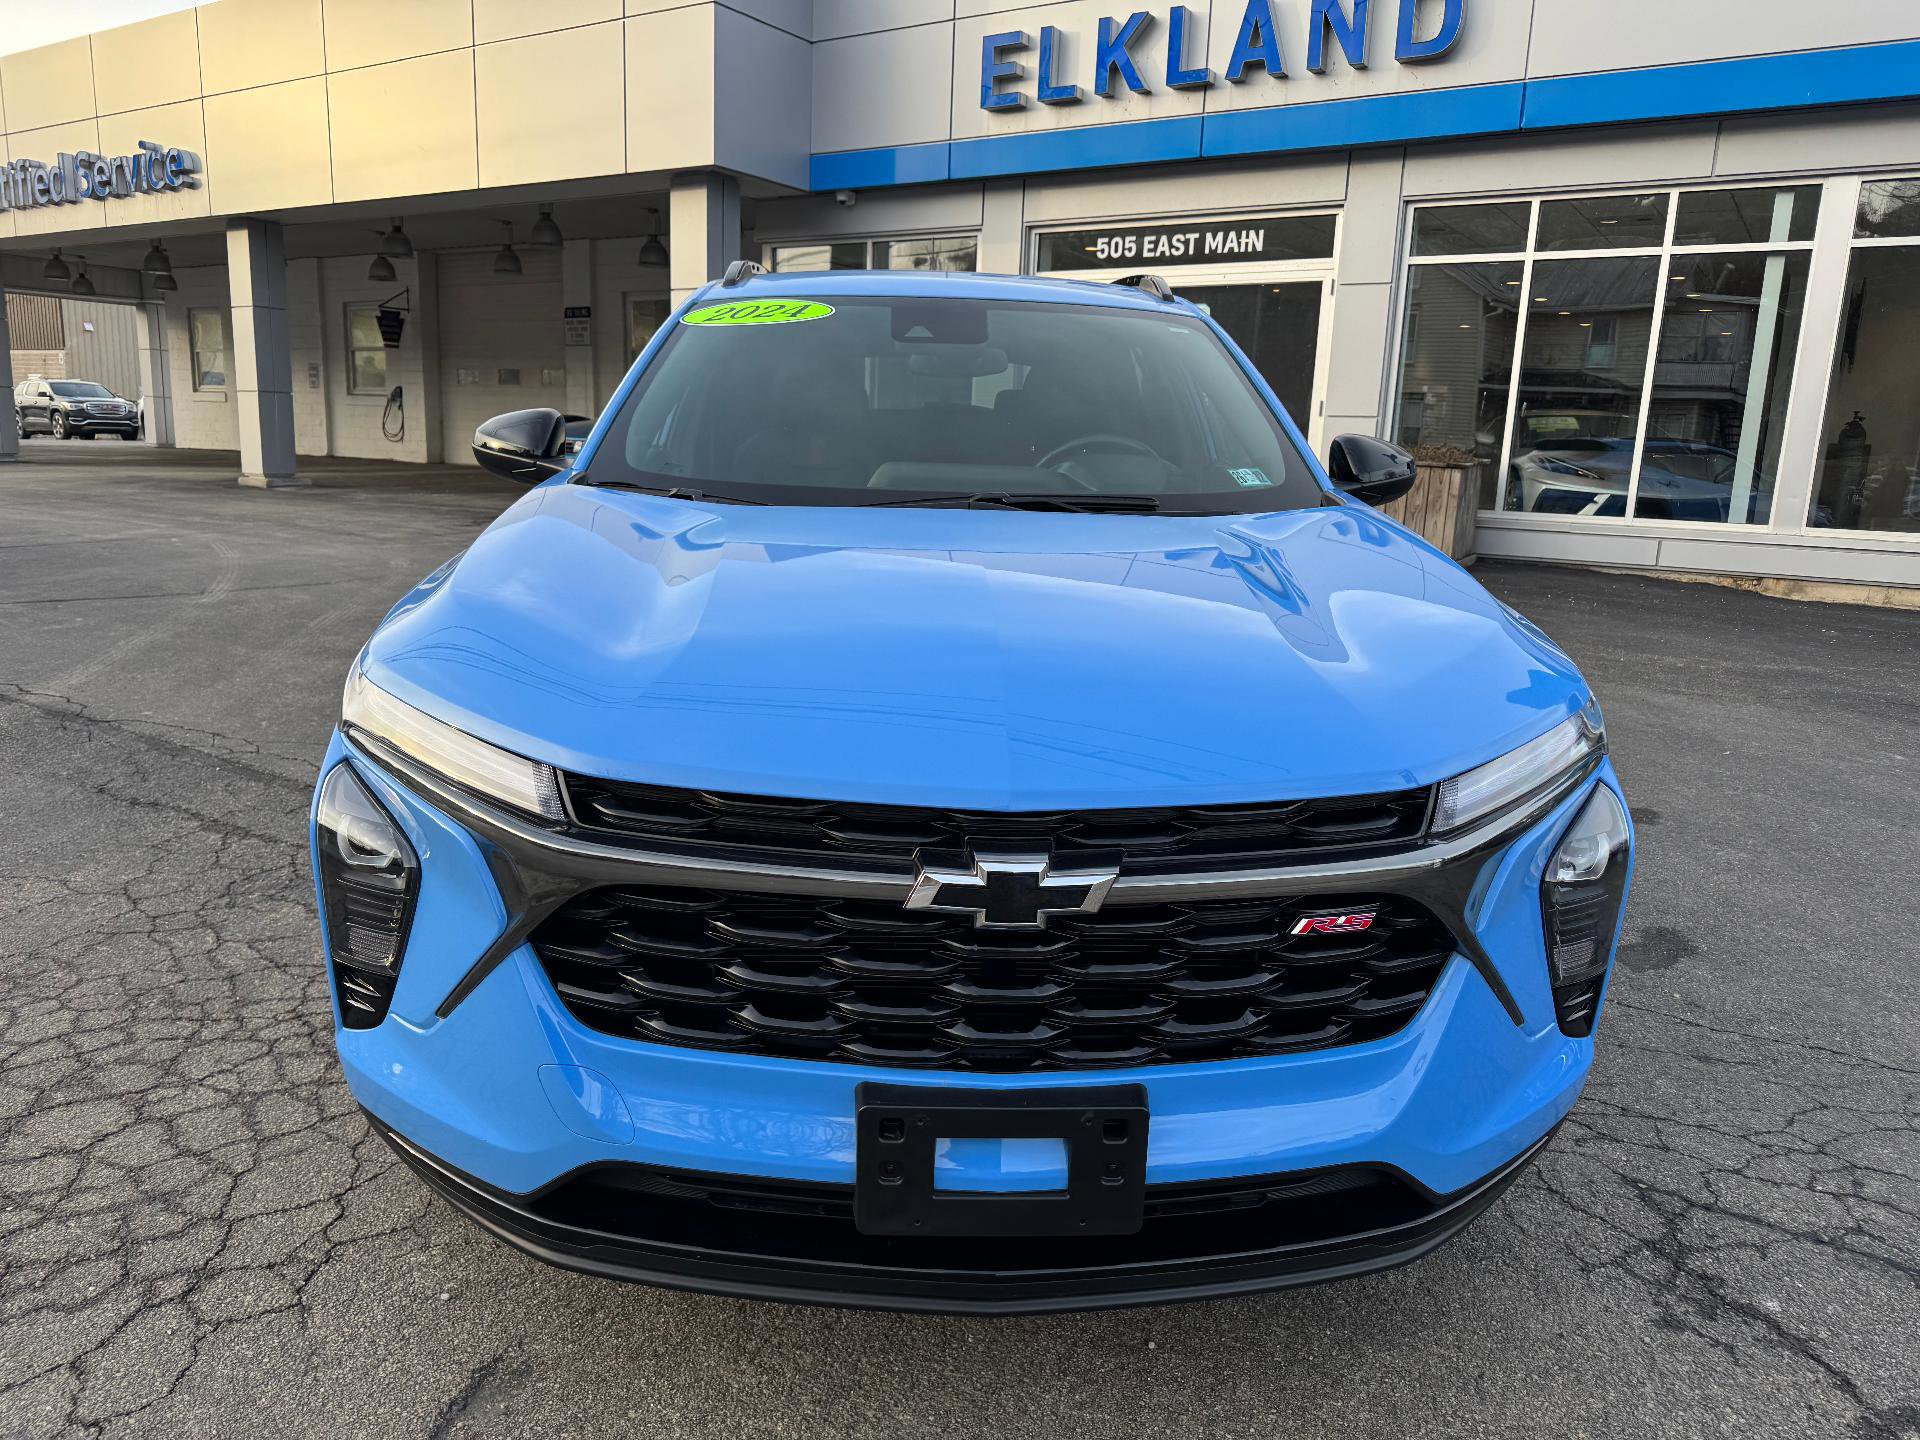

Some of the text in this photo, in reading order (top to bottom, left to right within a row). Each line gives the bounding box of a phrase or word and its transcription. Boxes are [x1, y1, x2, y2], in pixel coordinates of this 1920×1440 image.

[979, 0, 1467, 111] ELKLAND
[74, 140, 192, 199] Service
[1096, 229, 1265, 259] 505 EAST MAIN
[703, 304, 812, 323] 2024
[1290, 912, 1377, 935] RS
